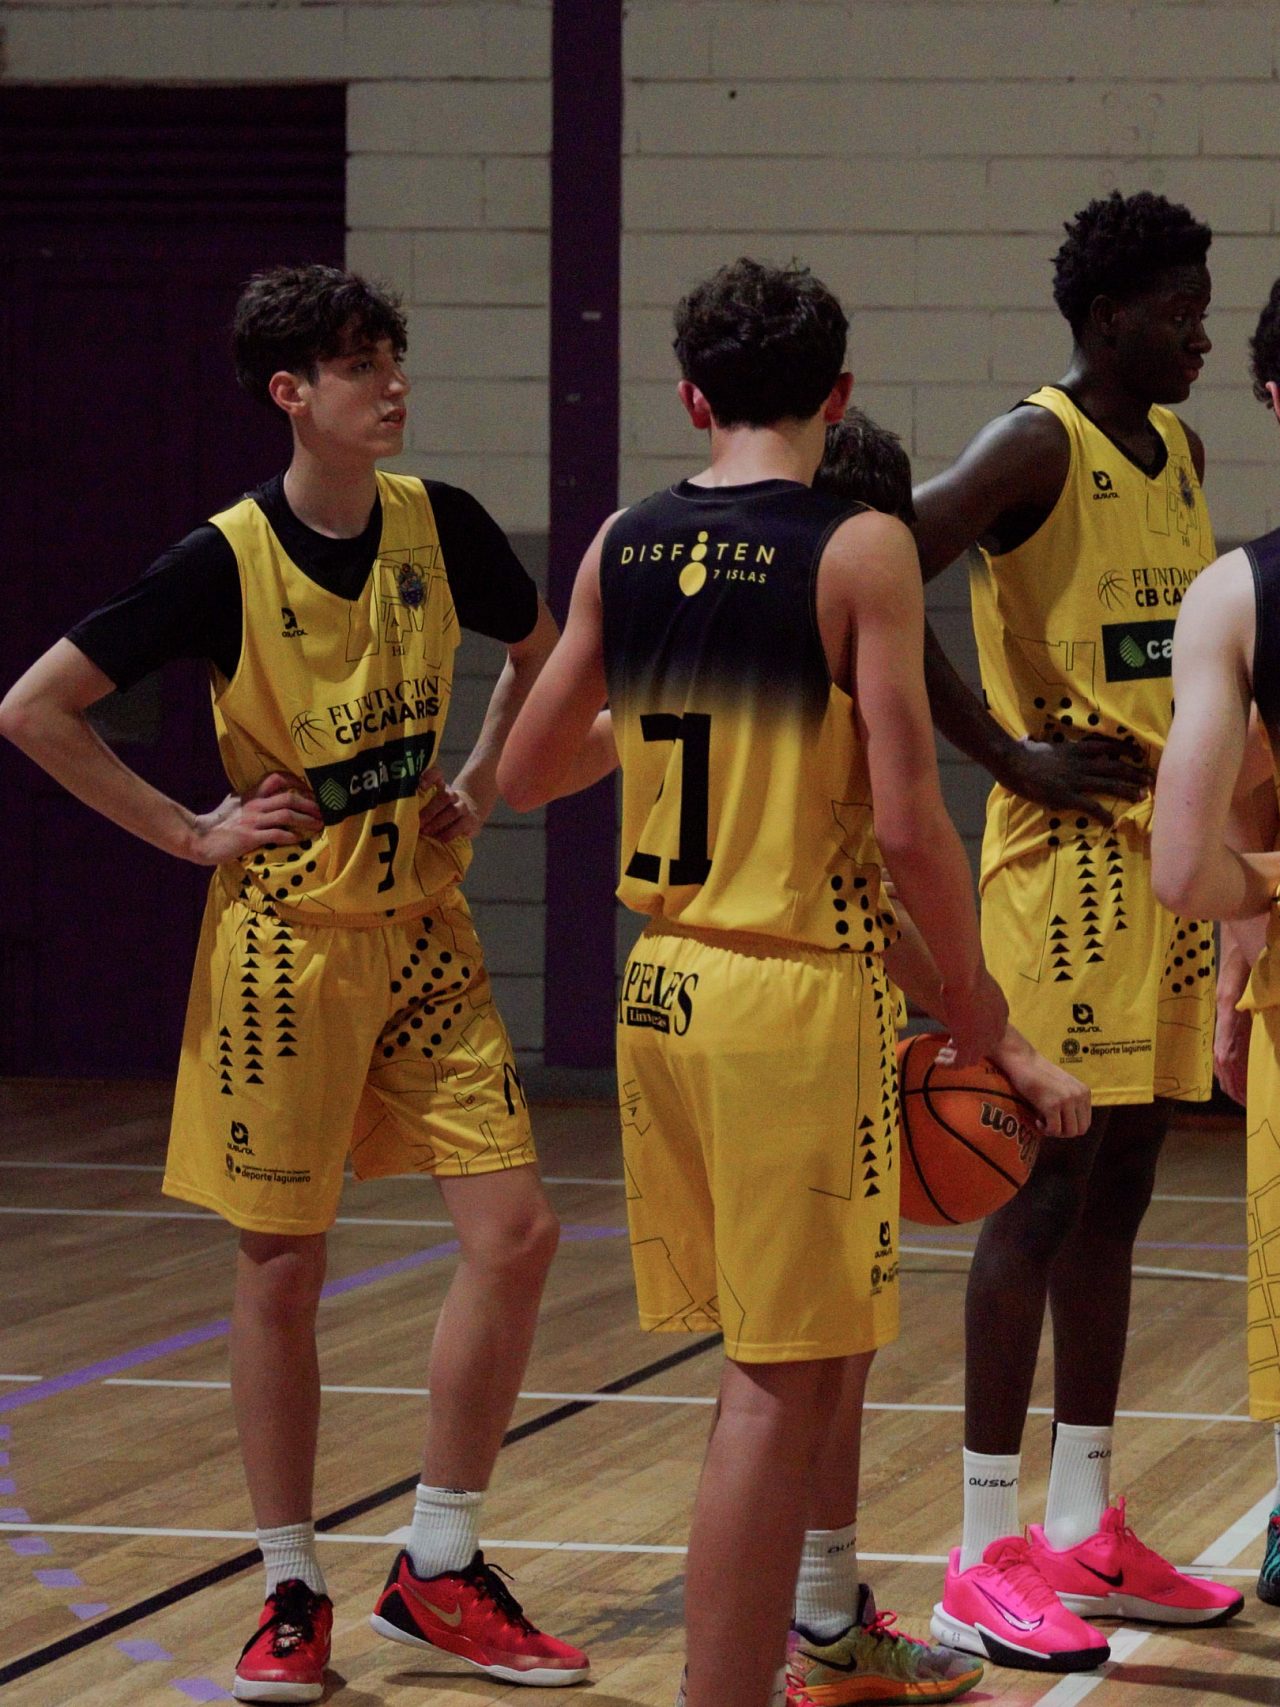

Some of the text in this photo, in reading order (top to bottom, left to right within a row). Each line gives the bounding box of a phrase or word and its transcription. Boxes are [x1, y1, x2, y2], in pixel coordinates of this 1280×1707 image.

[712, 568, 768, 584] 7 ISLAS
[1132, 567, 1206, 588] FUNDACI
[1135, 587, 1159, 608] CB
[619, 961, 699, 1037] PELES
[1089, 1046, 1120, 1057] deporte
[241, 1168, 272, 1182] deporte
[273, 1172, 312, 1185] lagunero
[968, 1477, 1019, 1488] austr
